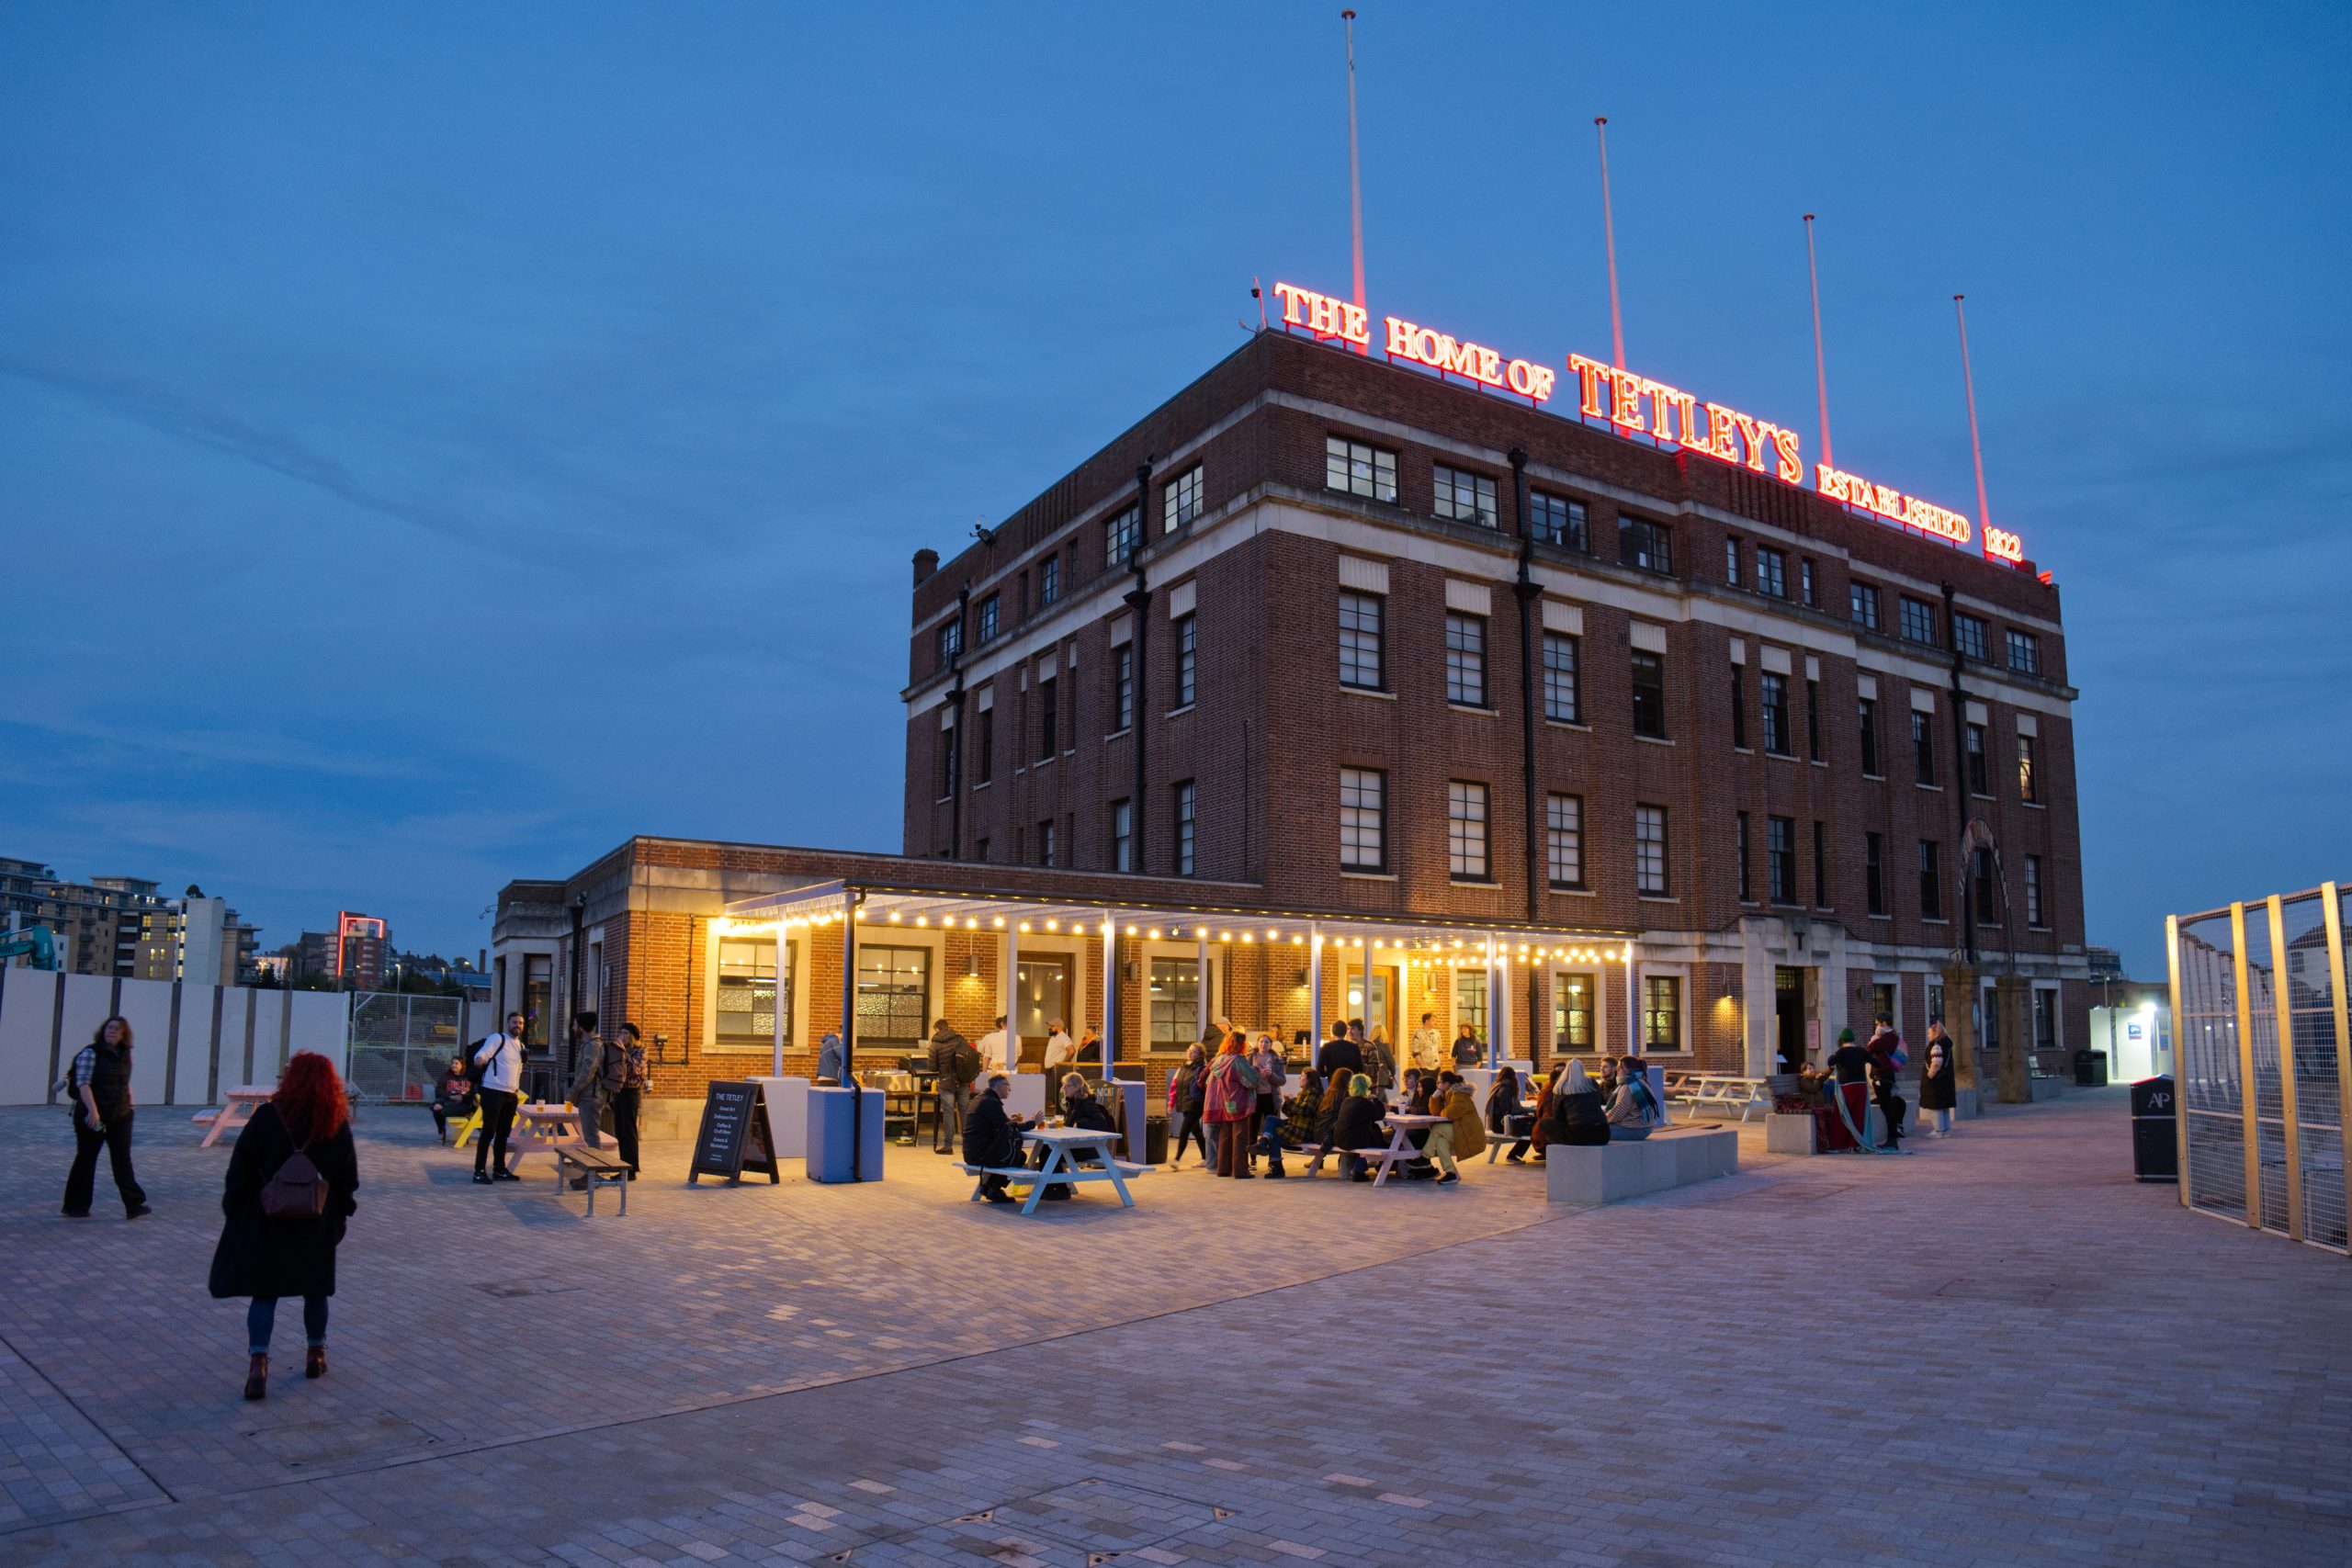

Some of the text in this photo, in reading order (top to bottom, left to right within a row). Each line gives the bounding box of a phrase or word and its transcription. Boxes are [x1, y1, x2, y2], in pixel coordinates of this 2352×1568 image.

[1273, 282, 2022, 562] THE HOME OF TETLEY'S ESTABLISHED 1822
[1793, 931, 1805, 951] T
[2147, 1092, 2170, 1109] AP
